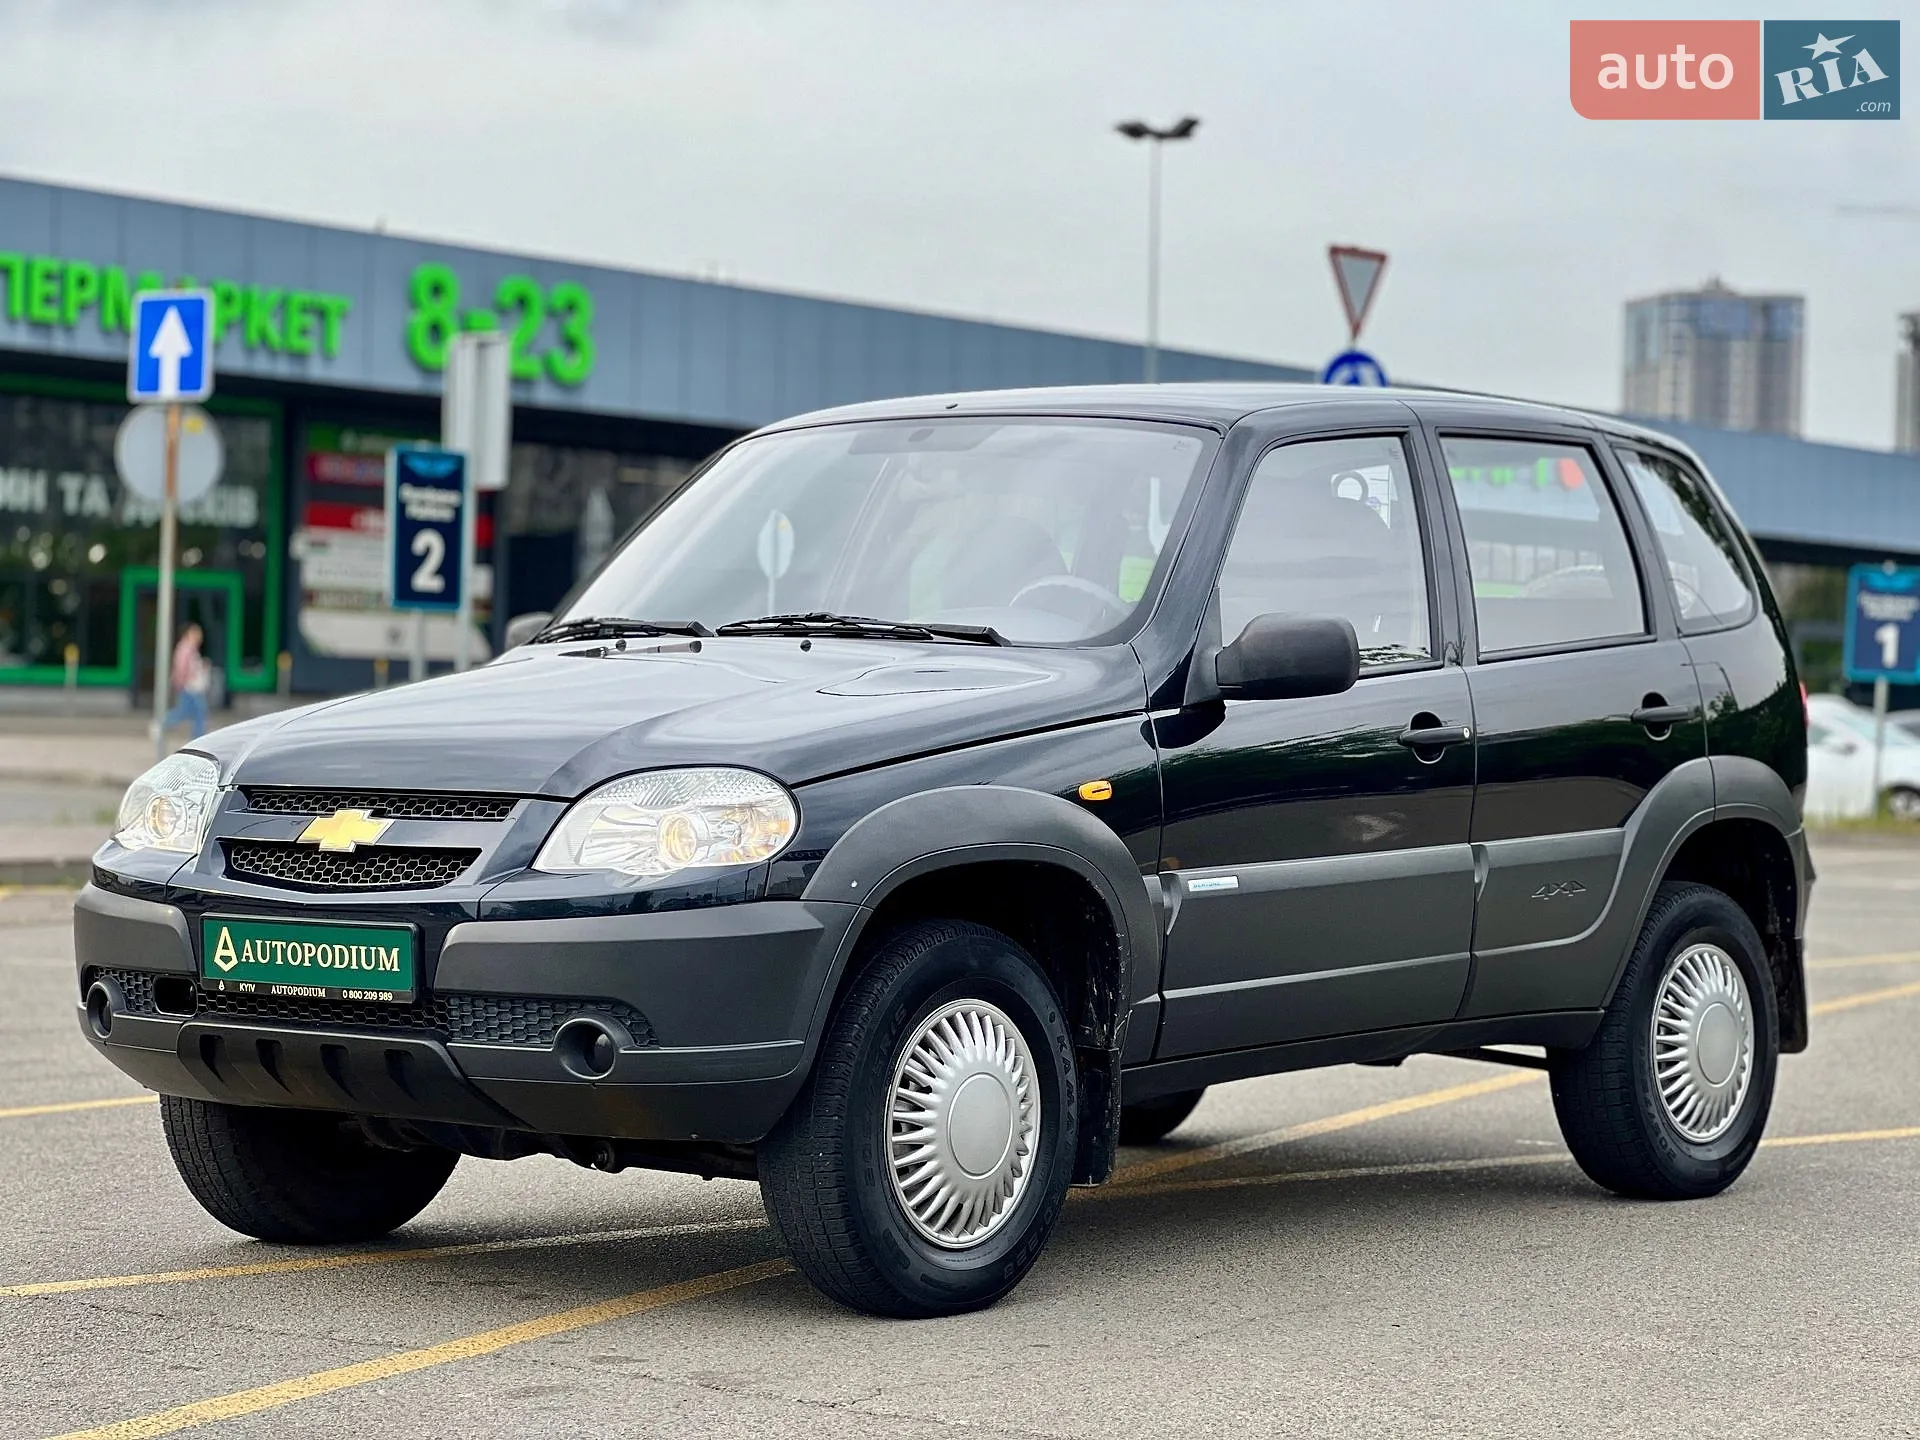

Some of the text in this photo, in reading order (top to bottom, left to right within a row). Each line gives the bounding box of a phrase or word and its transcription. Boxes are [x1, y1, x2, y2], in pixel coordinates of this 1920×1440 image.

[0, 252, 351, 357] ПЕРМРКЕТ
[411, 528, 446, 593] 2
[1875, 622, 1900, 669] 1
[240, 938, 401, 972] AUTOPODIUM
[239, 982, 393, 1001] KYIV AUTOPODIUM 0 800 209 989
